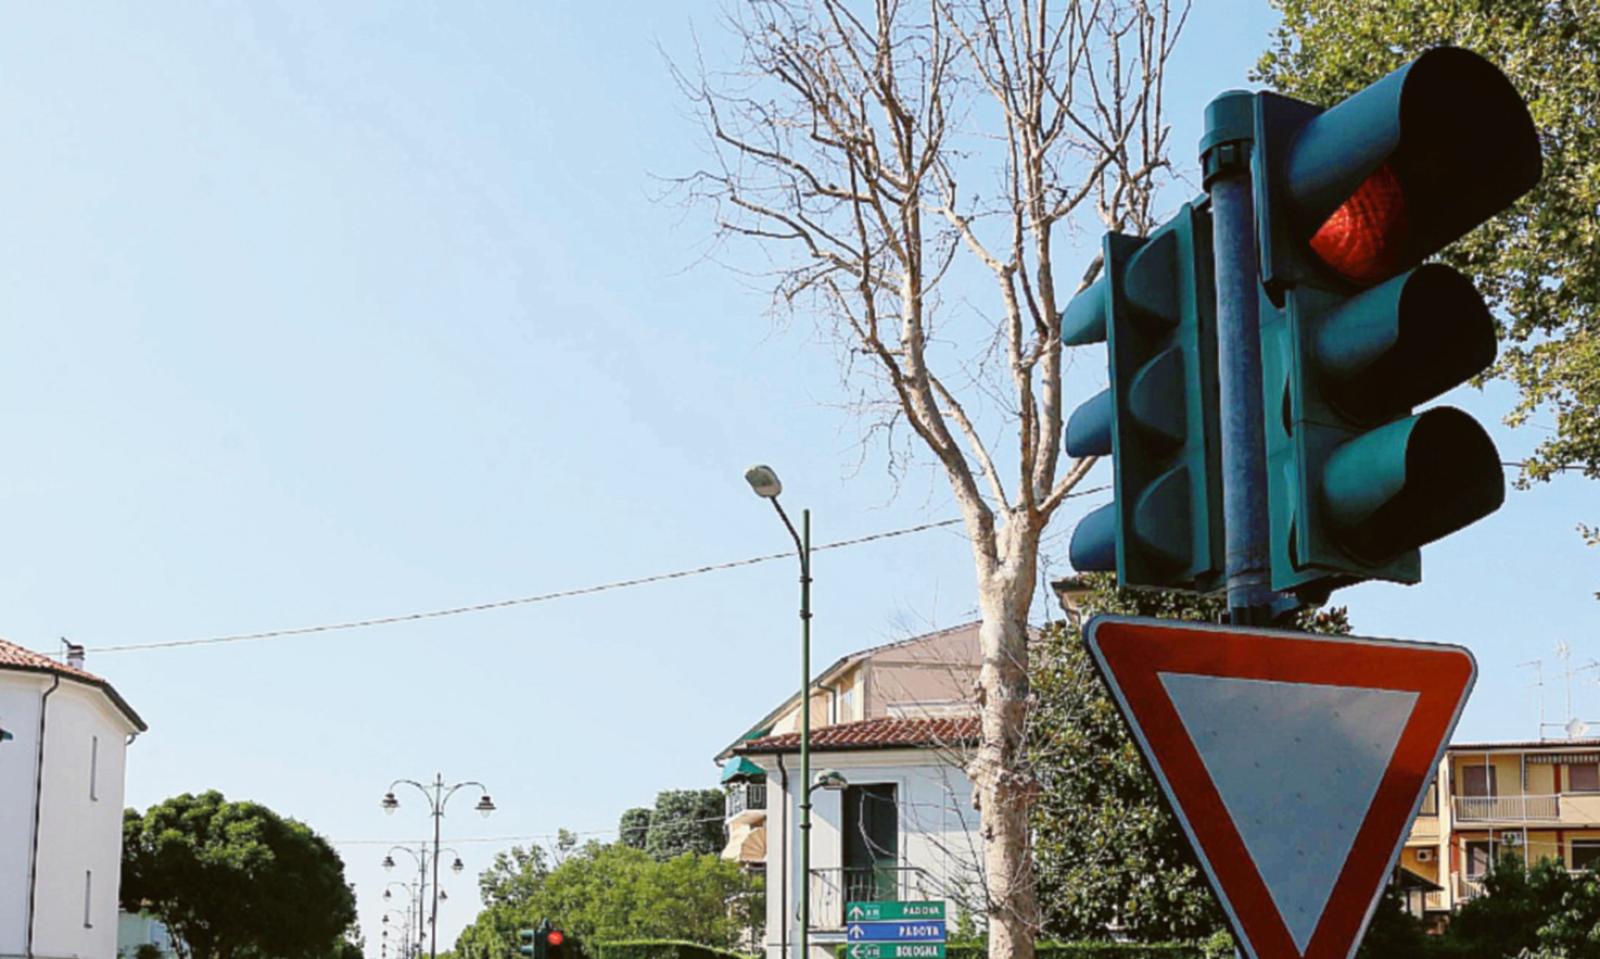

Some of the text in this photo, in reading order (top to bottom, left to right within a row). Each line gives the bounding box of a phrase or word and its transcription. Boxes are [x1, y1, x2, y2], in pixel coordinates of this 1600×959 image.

[903, 906, 940, 915] PADOVA
[899, 926, 939, 936] PADOVA
[896, 945, 938, 957] BOLOGNA
